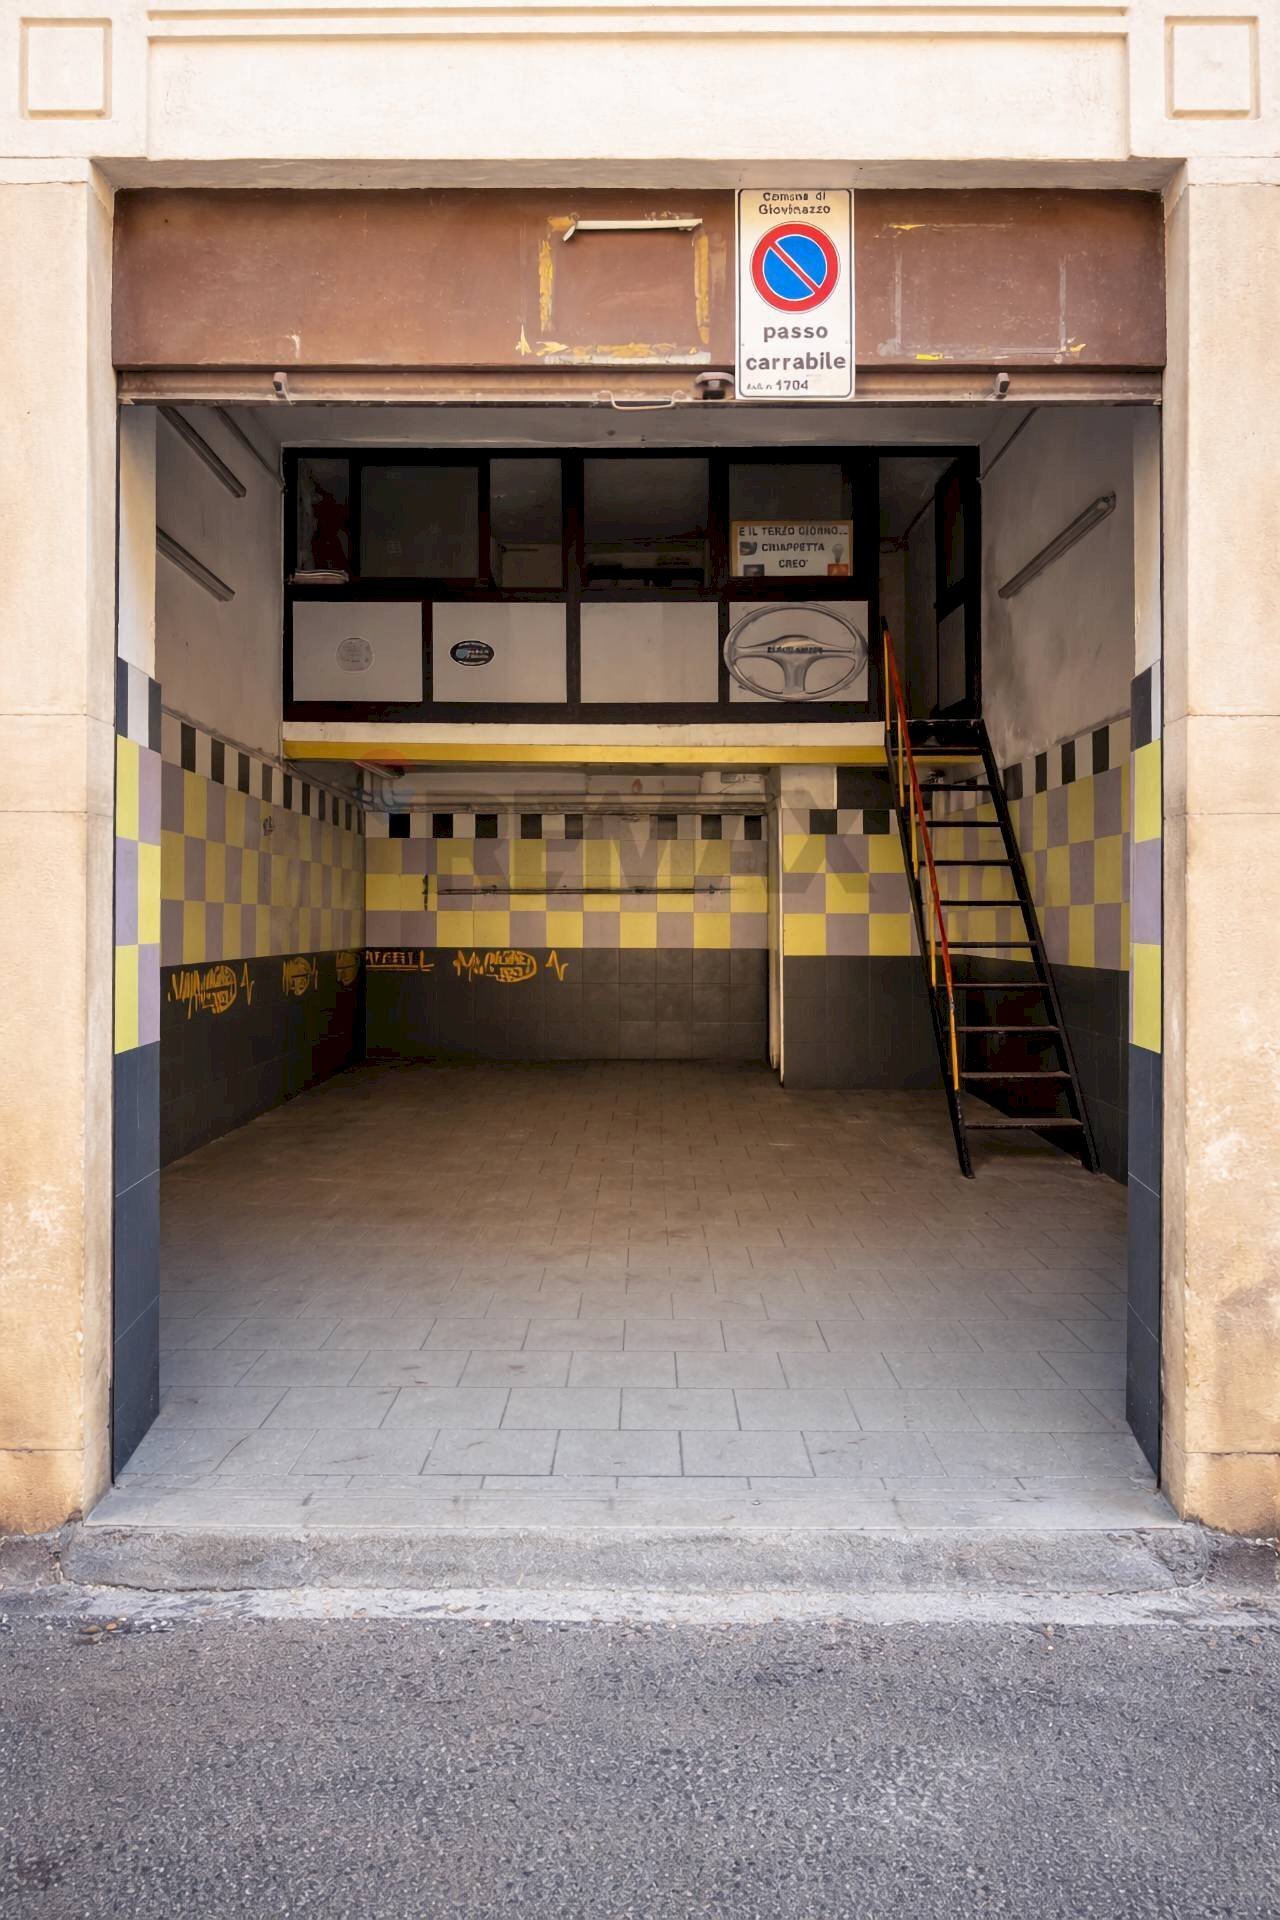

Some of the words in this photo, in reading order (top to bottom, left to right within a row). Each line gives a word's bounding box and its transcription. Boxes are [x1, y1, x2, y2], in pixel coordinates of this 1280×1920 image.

[816, 191, 826, 201] di
[758, 204, 831, 215] Giovinazzo
[763, 325, 828, 342] passo
[745, 352, 846, 370] carrabile
[775, 380, 809, 391] 1704
[749, 527, 758, 536] IL
[762, 526, 795, 536] TERZO
[761, 542, 825, 552] CHIAPPETTA
